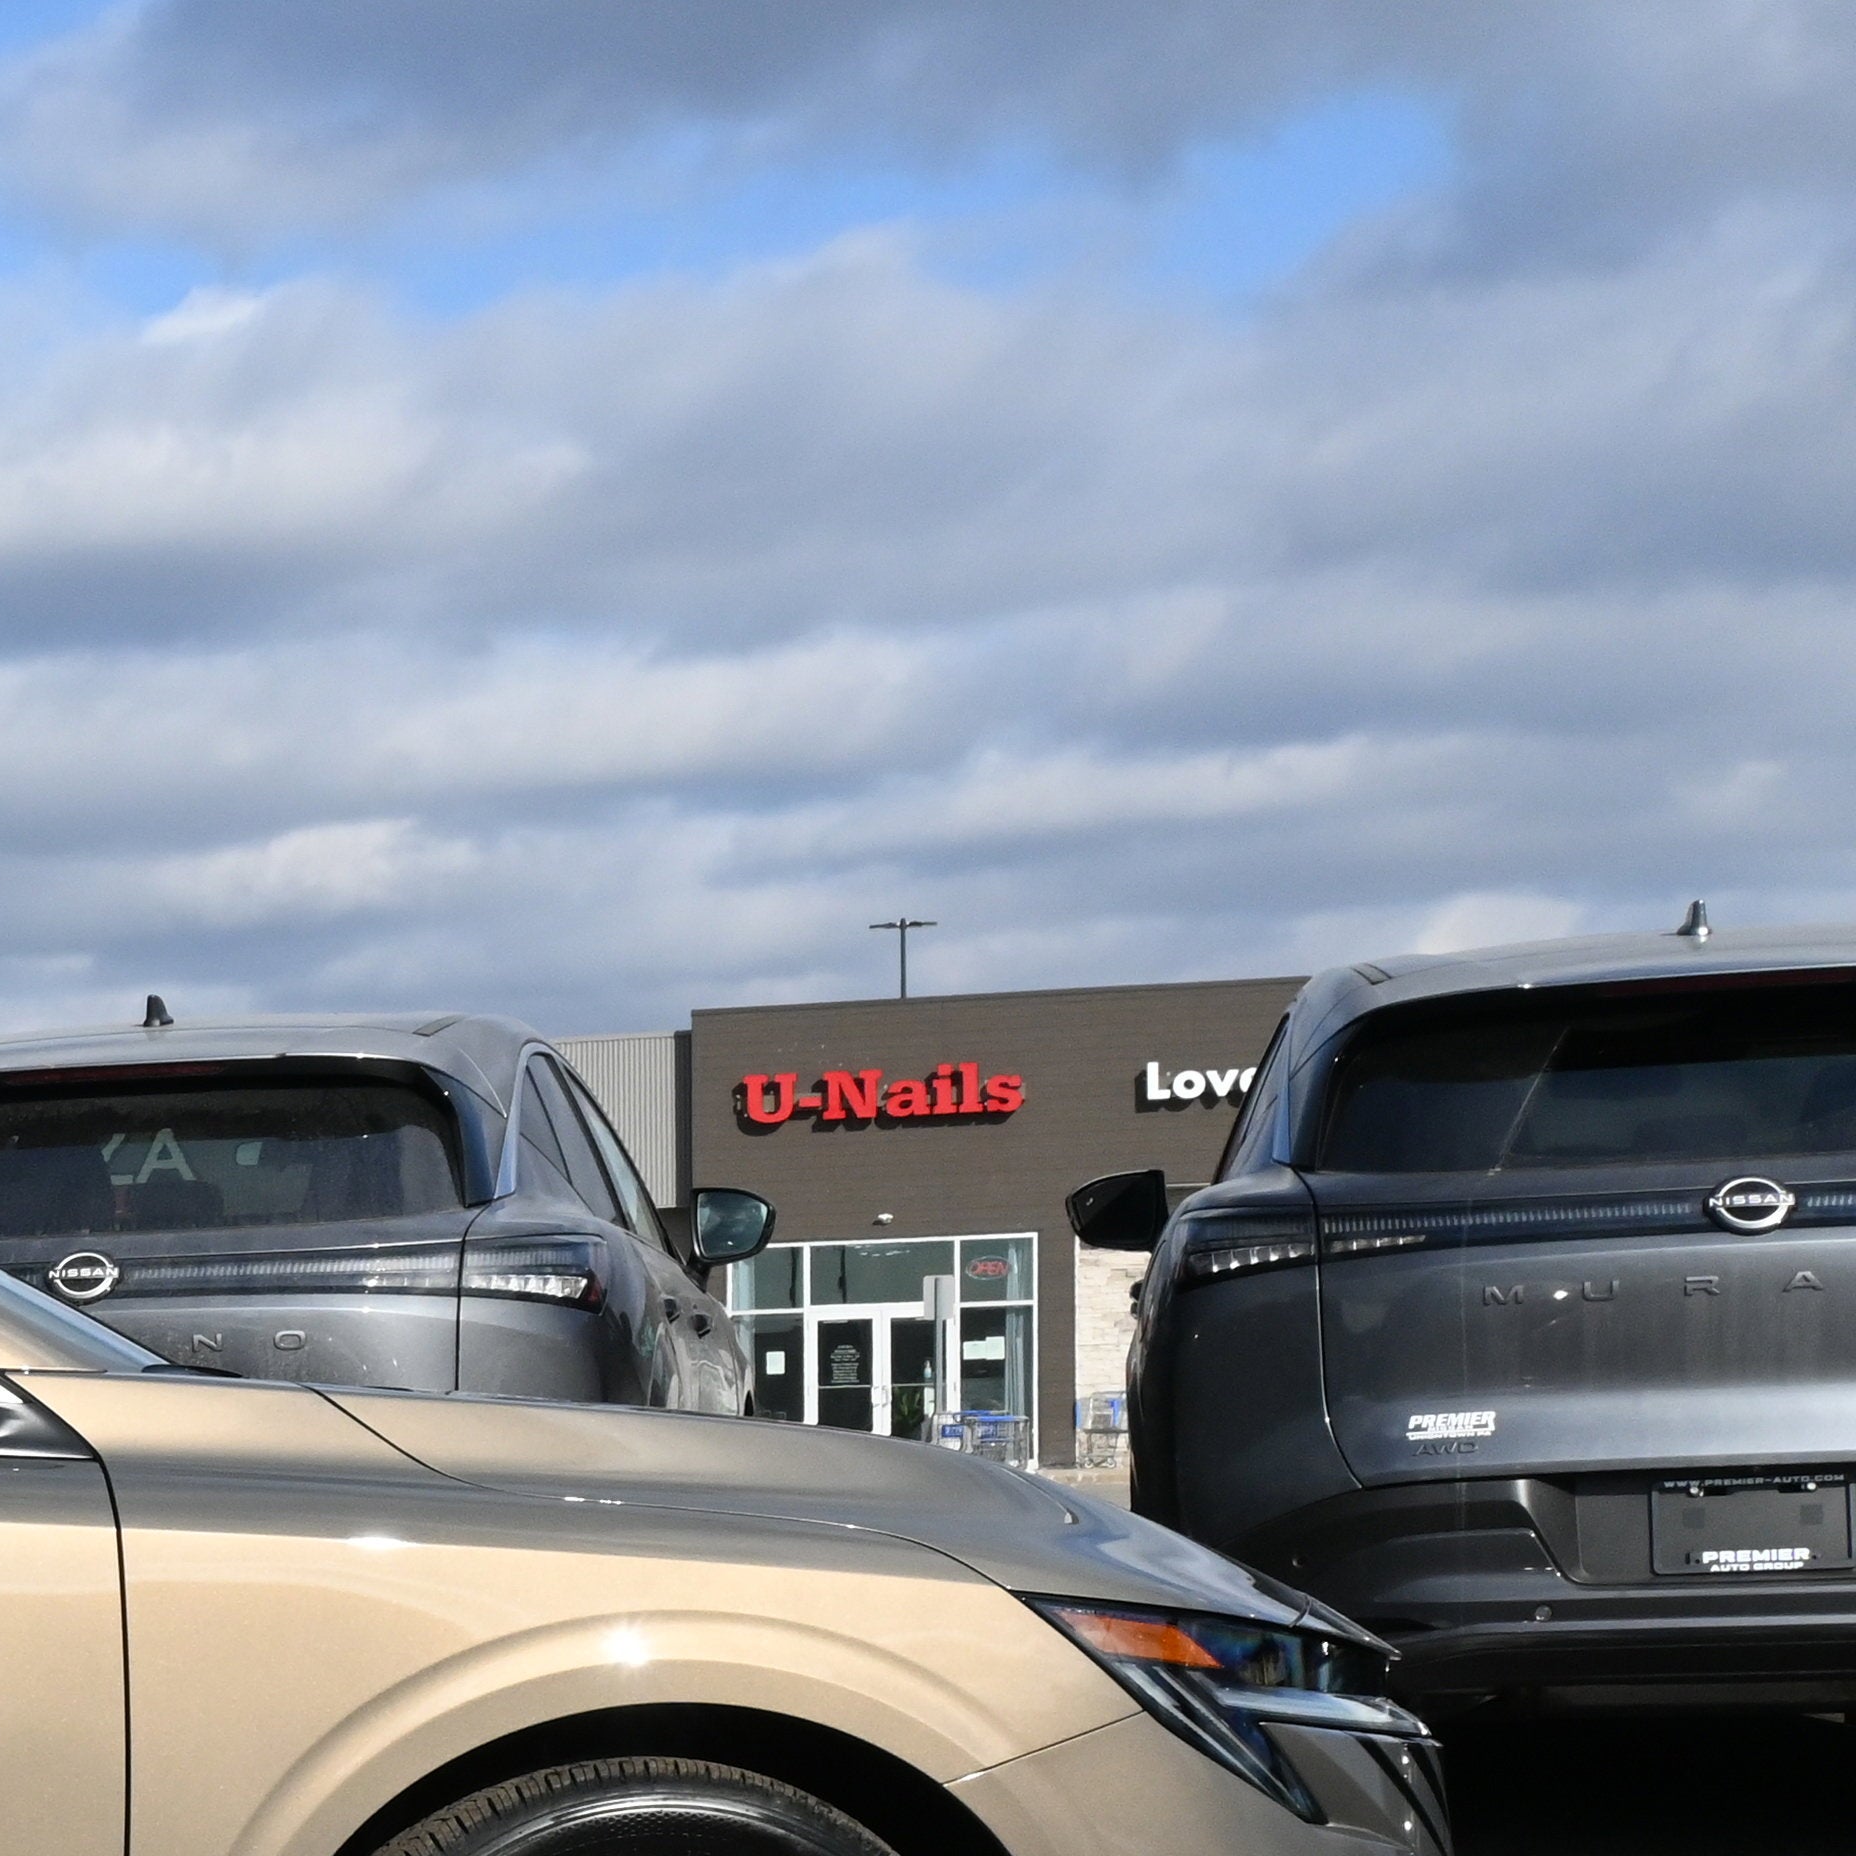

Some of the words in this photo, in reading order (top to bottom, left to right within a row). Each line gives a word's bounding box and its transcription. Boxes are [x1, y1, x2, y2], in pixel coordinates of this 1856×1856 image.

[742, 1062, 1024, 1124] U-Nails
[1708, 1192, 1796, 1208] NISSAN
[48, 1267, 120, 1280] NISSAN
[970, 1261, 1008, 1275] OPEN
[1408, 1411, 1496, 1430] PREMIER
[1412, 1441, 1479, 1457] AWD
[1663, 1474, 1845, 1488] WWW.PREMIER-AUTO.COM
[1702, 1547, 1811, 1564] PREMIER
[1710, 1562, 1751, 1573] AUTO
[1753, 1561, 1805, 1571] GROUP
